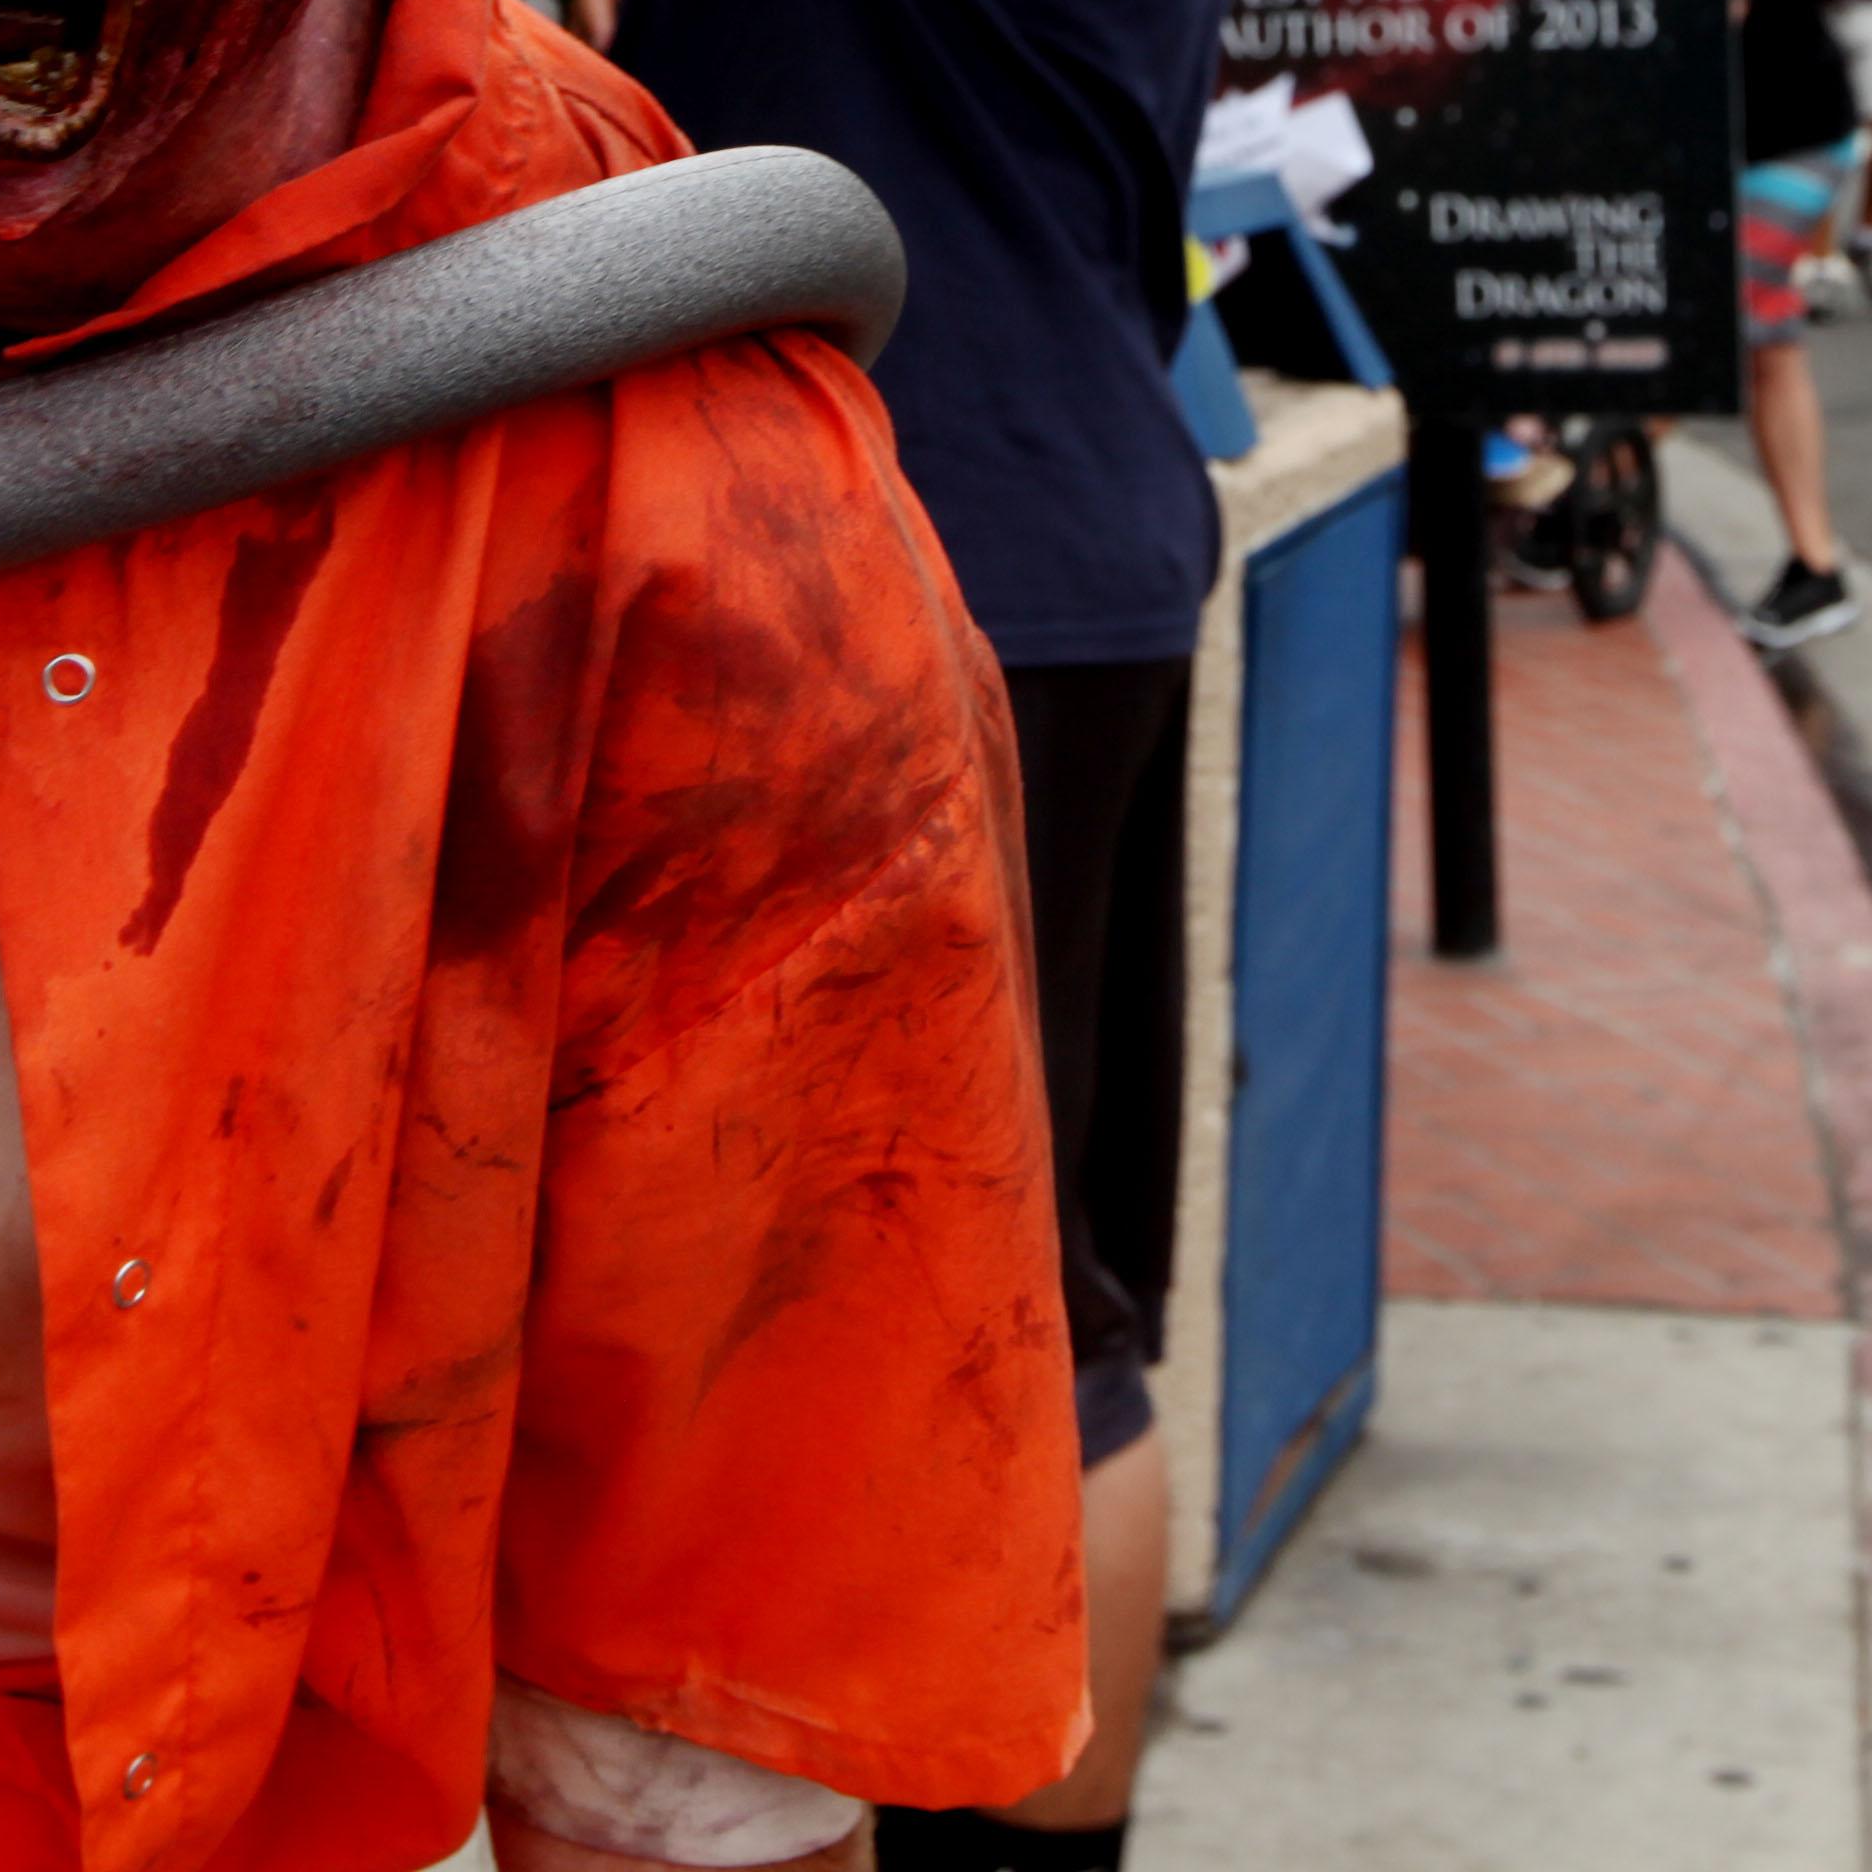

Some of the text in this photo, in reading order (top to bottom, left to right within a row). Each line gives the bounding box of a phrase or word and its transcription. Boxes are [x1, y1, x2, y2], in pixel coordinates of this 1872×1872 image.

[1218, 7, 1436, 61] AUTHOR
[1443, 2, 1517, 55] OF
[1430, 192, 1664, 245] DRAWING
[1574, 236, 1663, 277] THE
[1456, 270, 1668, 319] DRAGON
